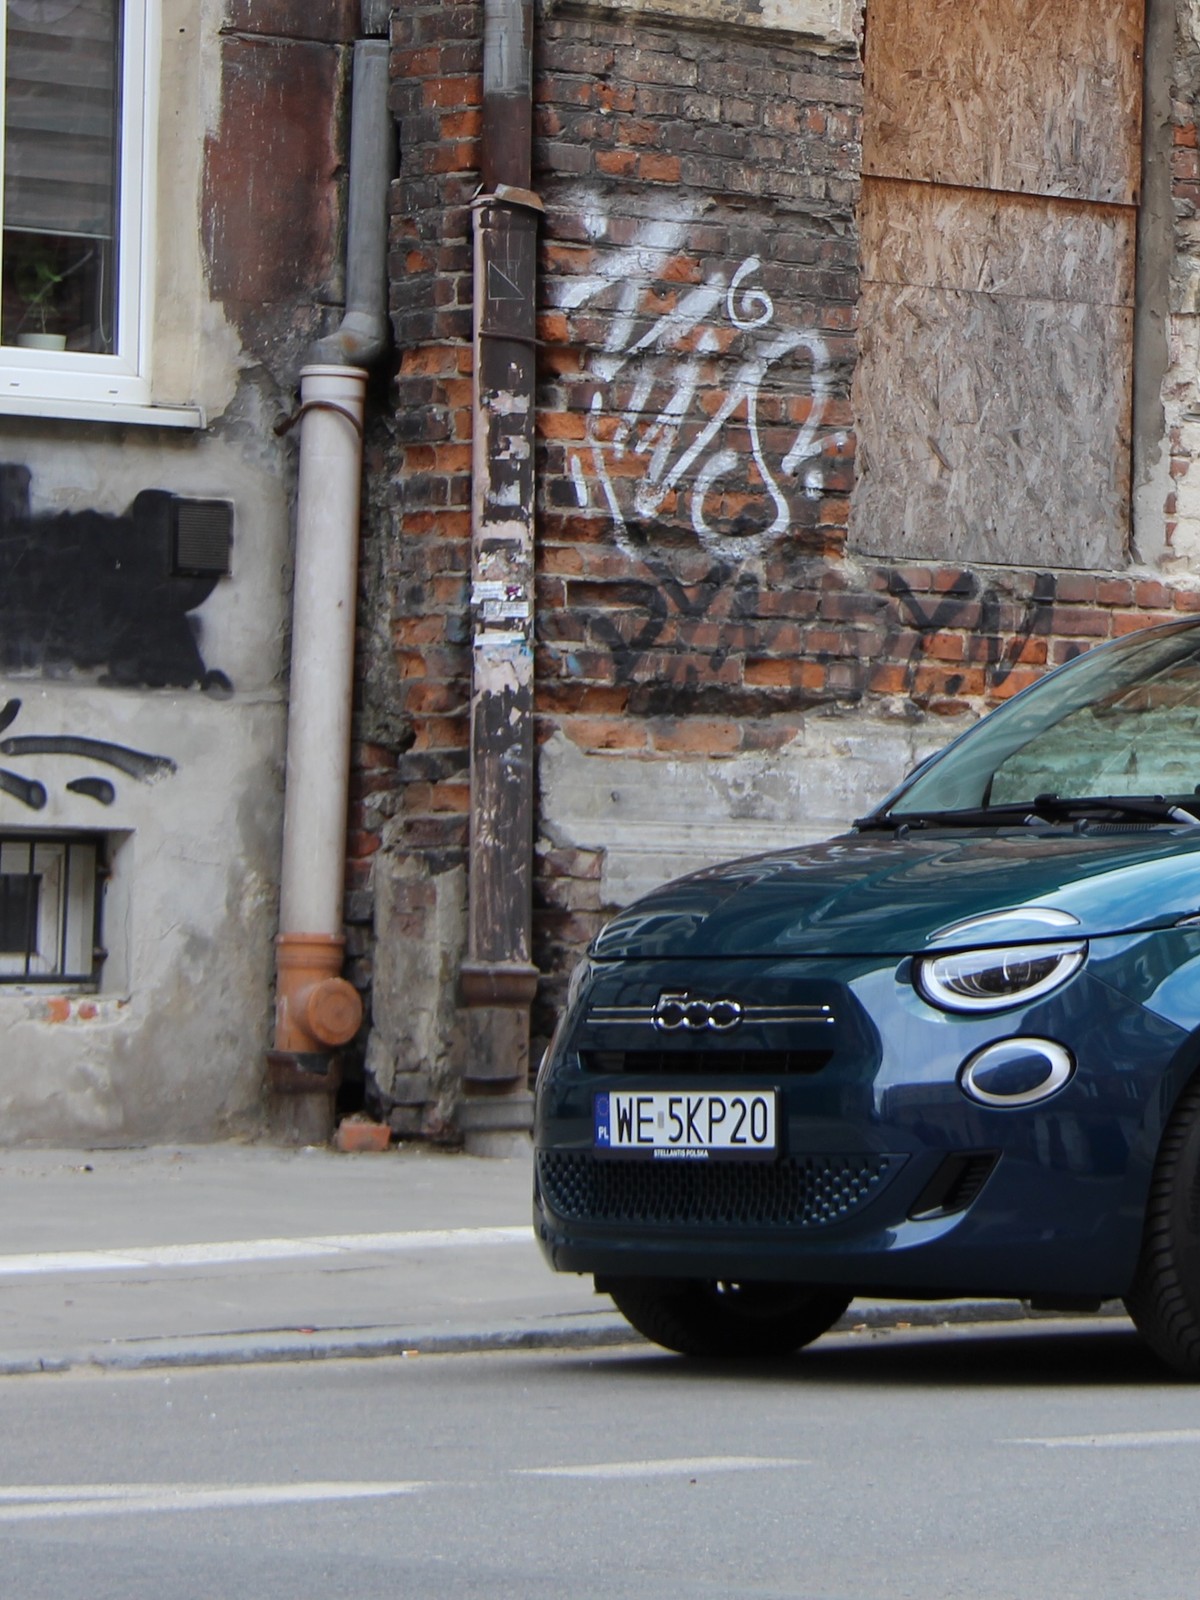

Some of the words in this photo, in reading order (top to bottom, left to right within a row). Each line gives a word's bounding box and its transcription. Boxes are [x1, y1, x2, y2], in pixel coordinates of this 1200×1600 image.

[655, 991, 743, 1029] 500
[598, 1126, 609, 1139] PL
[616, 1097, 654, 1143] WE
[668, 1097, 768, 1144] 5KP20
[653, 1149, 685, 1158] STELLANTIS
[686, 1149, 709, 1158] POLSKA
